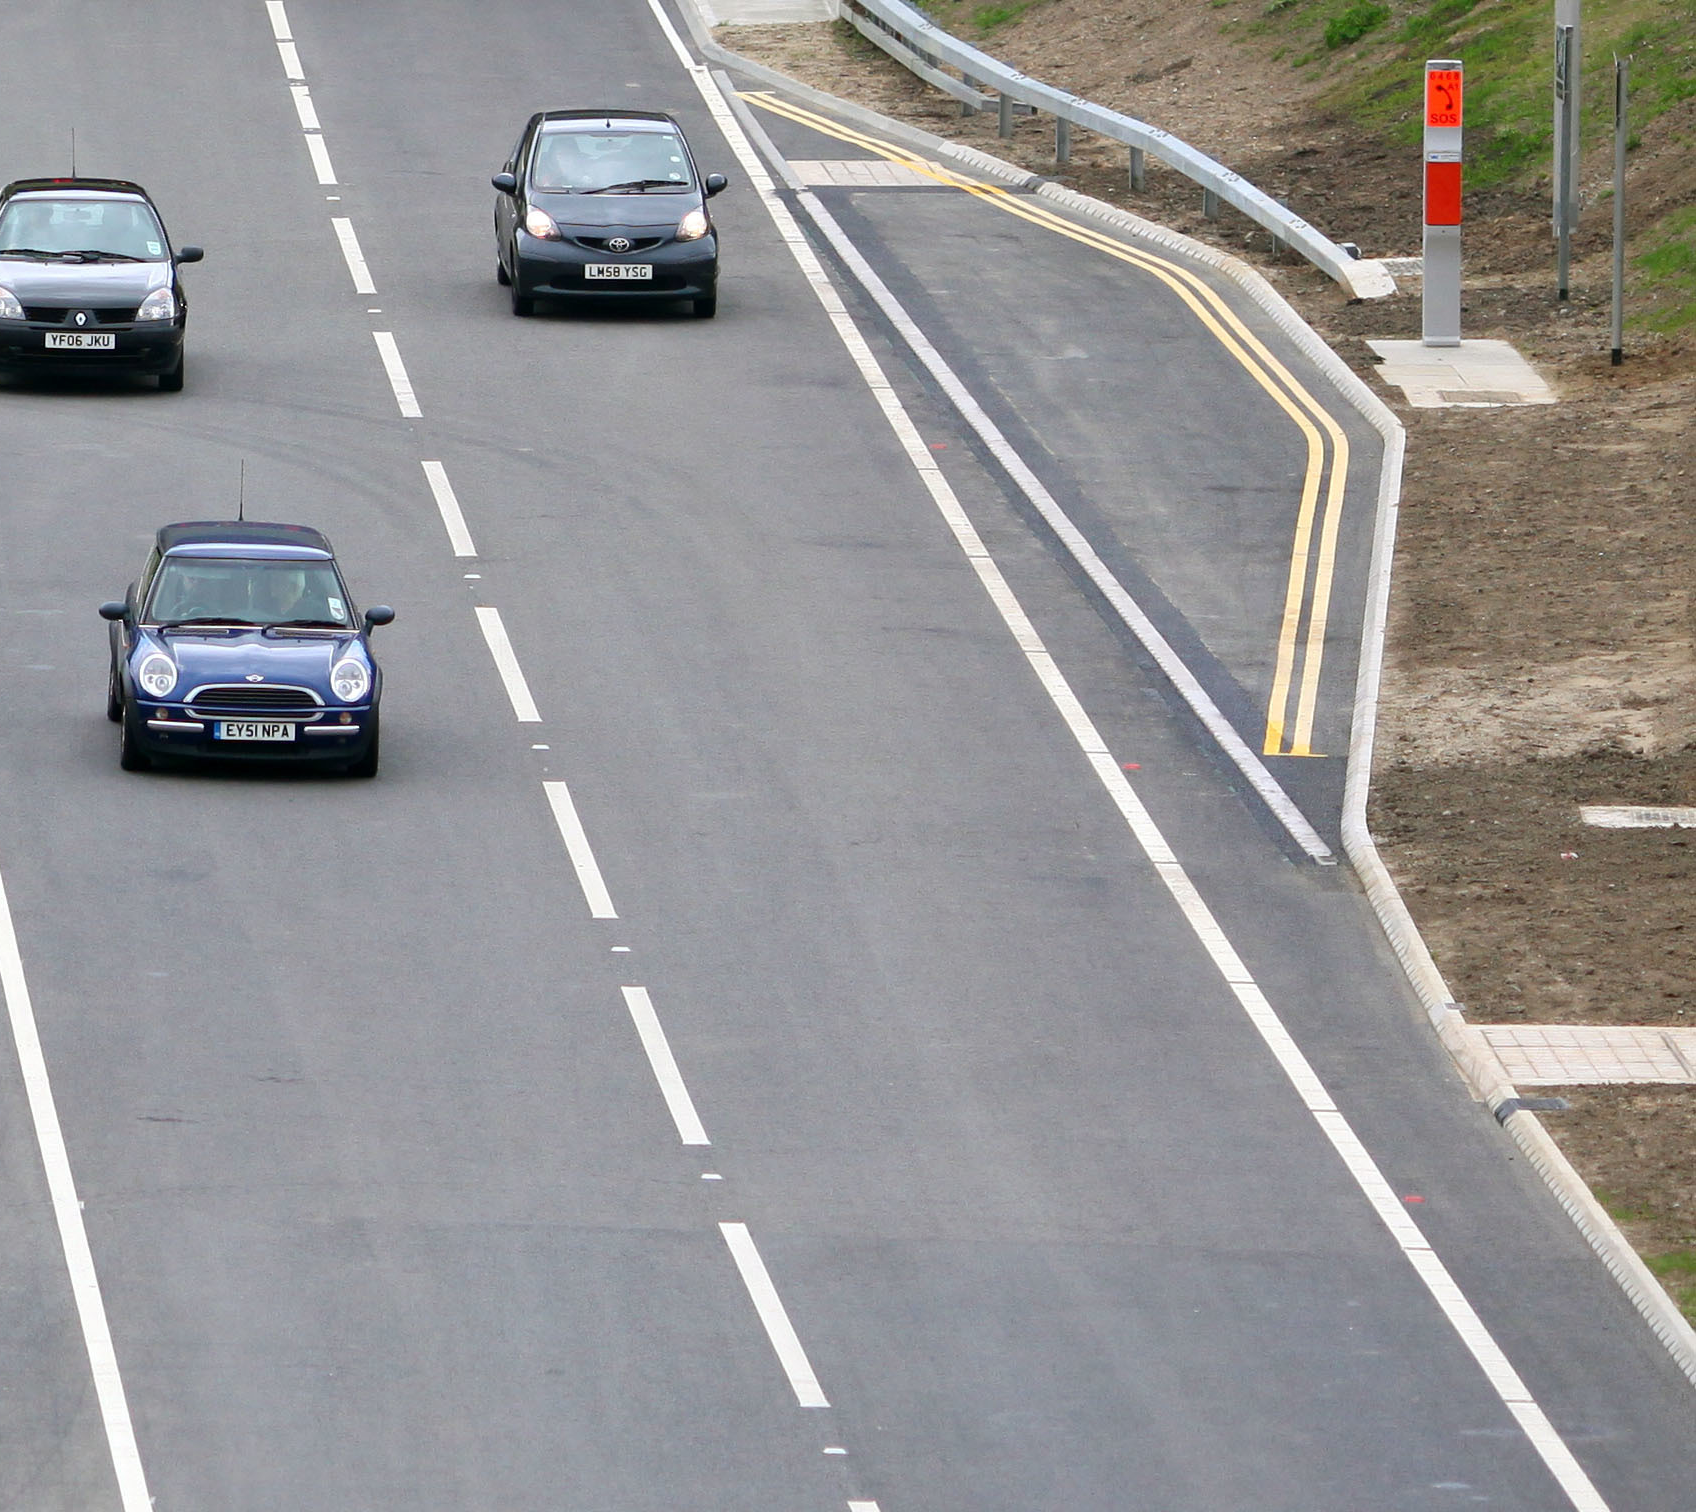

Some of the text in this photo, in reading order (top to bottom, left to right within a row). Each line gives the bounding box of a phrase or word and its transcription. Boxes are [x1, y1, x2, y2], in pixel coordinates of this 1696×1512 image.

[1430, 113, 1458, 124] SOS
[623, 267, 647, 278] YSG
[51, 334, 110, 347] YF06 JKU
[226, 724, 290, 738] EY51 NPA
